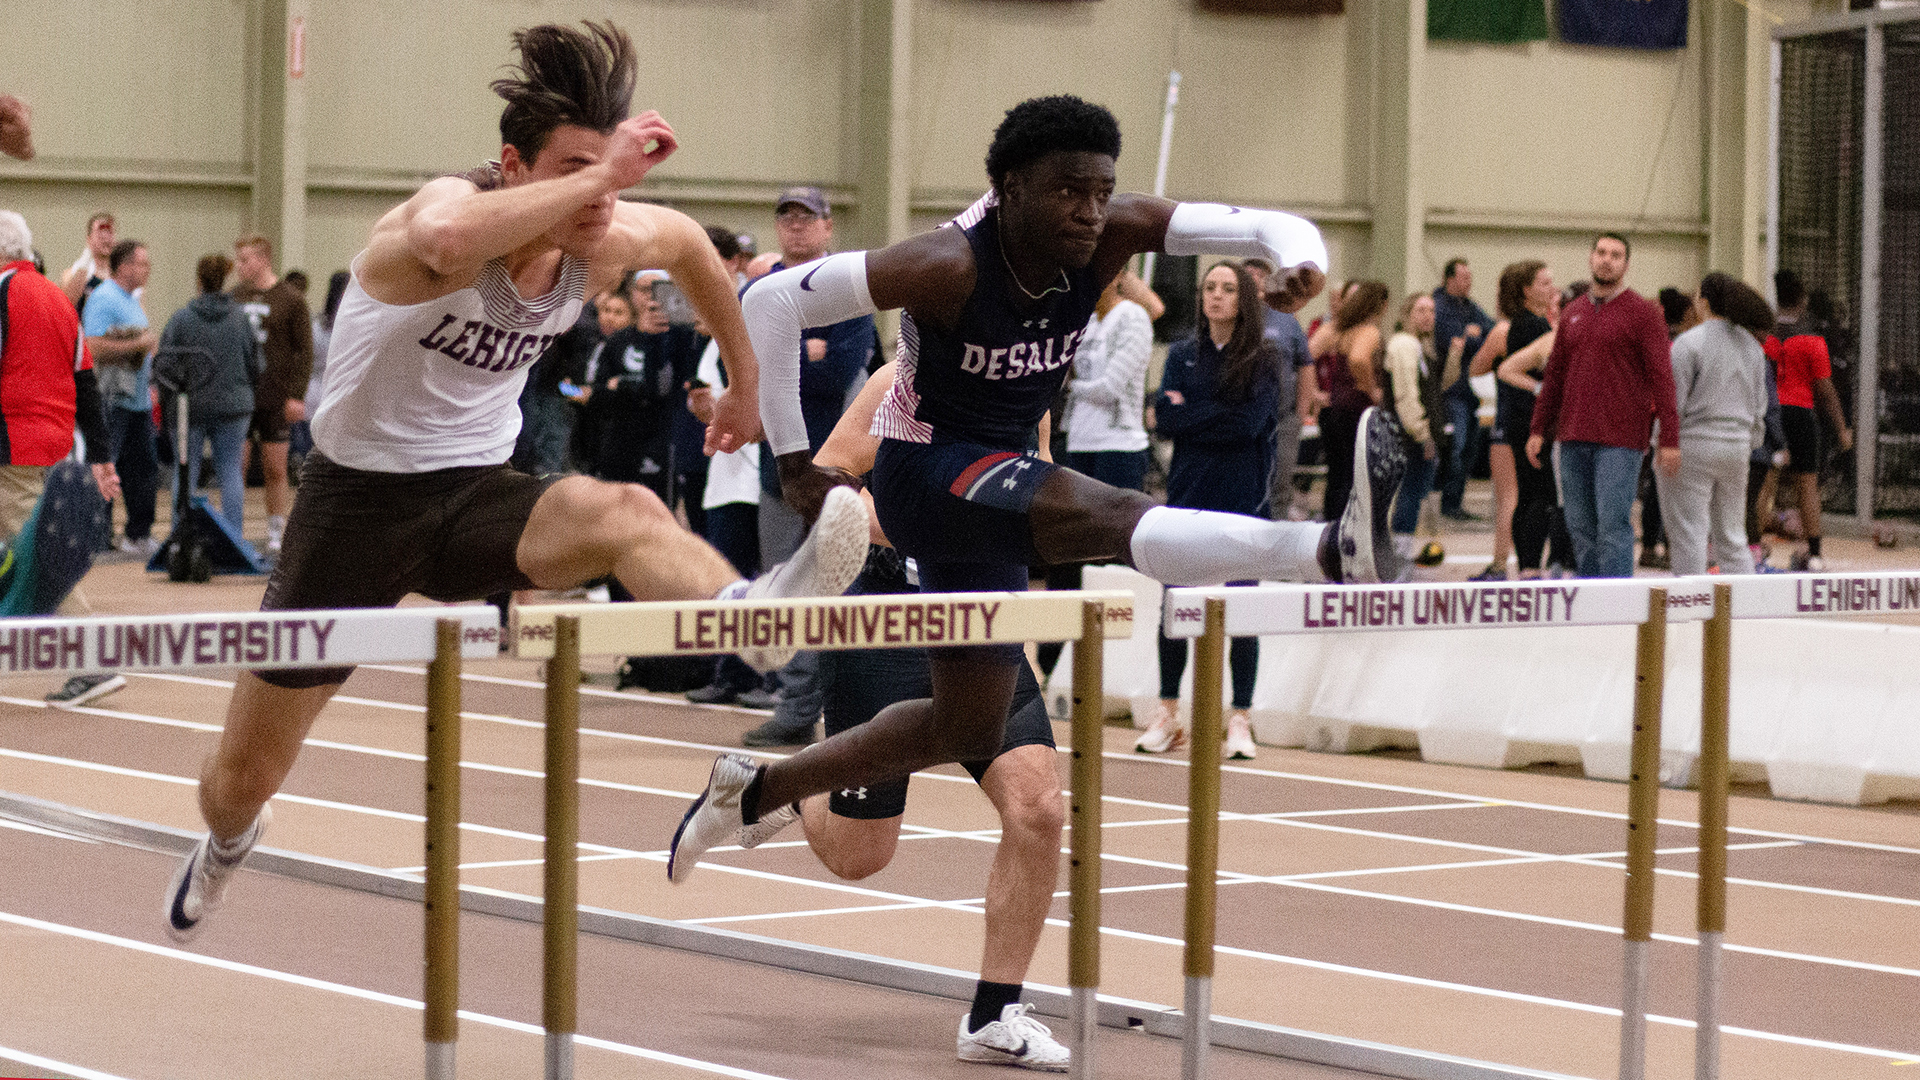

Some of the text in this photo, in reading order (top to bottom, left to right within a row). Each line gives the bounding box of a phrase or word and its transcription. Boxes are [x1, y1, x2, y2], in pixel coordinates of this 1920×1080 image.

[1303, 586, 1579, 628] LEHIGH UNIVERSITY
[1797, 578, 1881, 613] LEHIGH
[97, 619, 336, 667] UNIVERSITY
[674, 602, 1001, 650] LEHIGH UNIVERSITY
